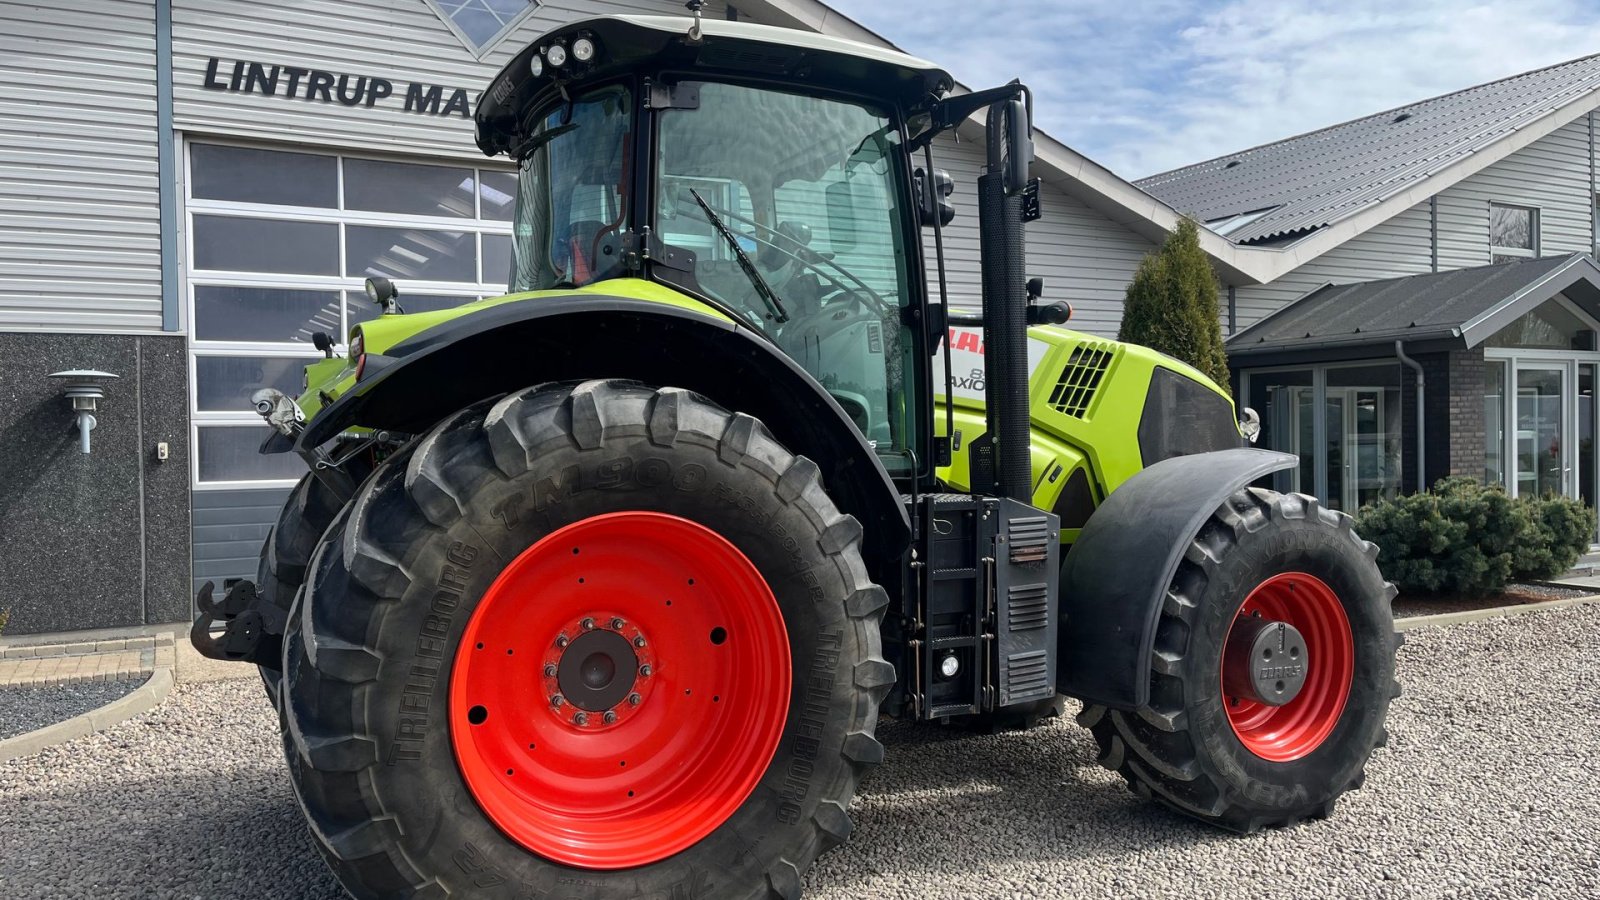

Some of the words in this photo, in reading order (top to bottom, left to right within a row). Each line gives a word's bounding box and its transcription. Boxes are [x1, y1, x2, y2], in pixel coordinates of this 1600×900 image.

[204, 57, 393, 108] LINTRUP
[404, 82, 482, 119] MA
[490, 456, 707, 531] TM900
[766, 521, 827, 605] POWER
[385, 540, 479, 767] TRELLEBORG
[775, 629, 844, 827] TRELLEBORG
[1259, 664, 1302, 681] CLAAS
